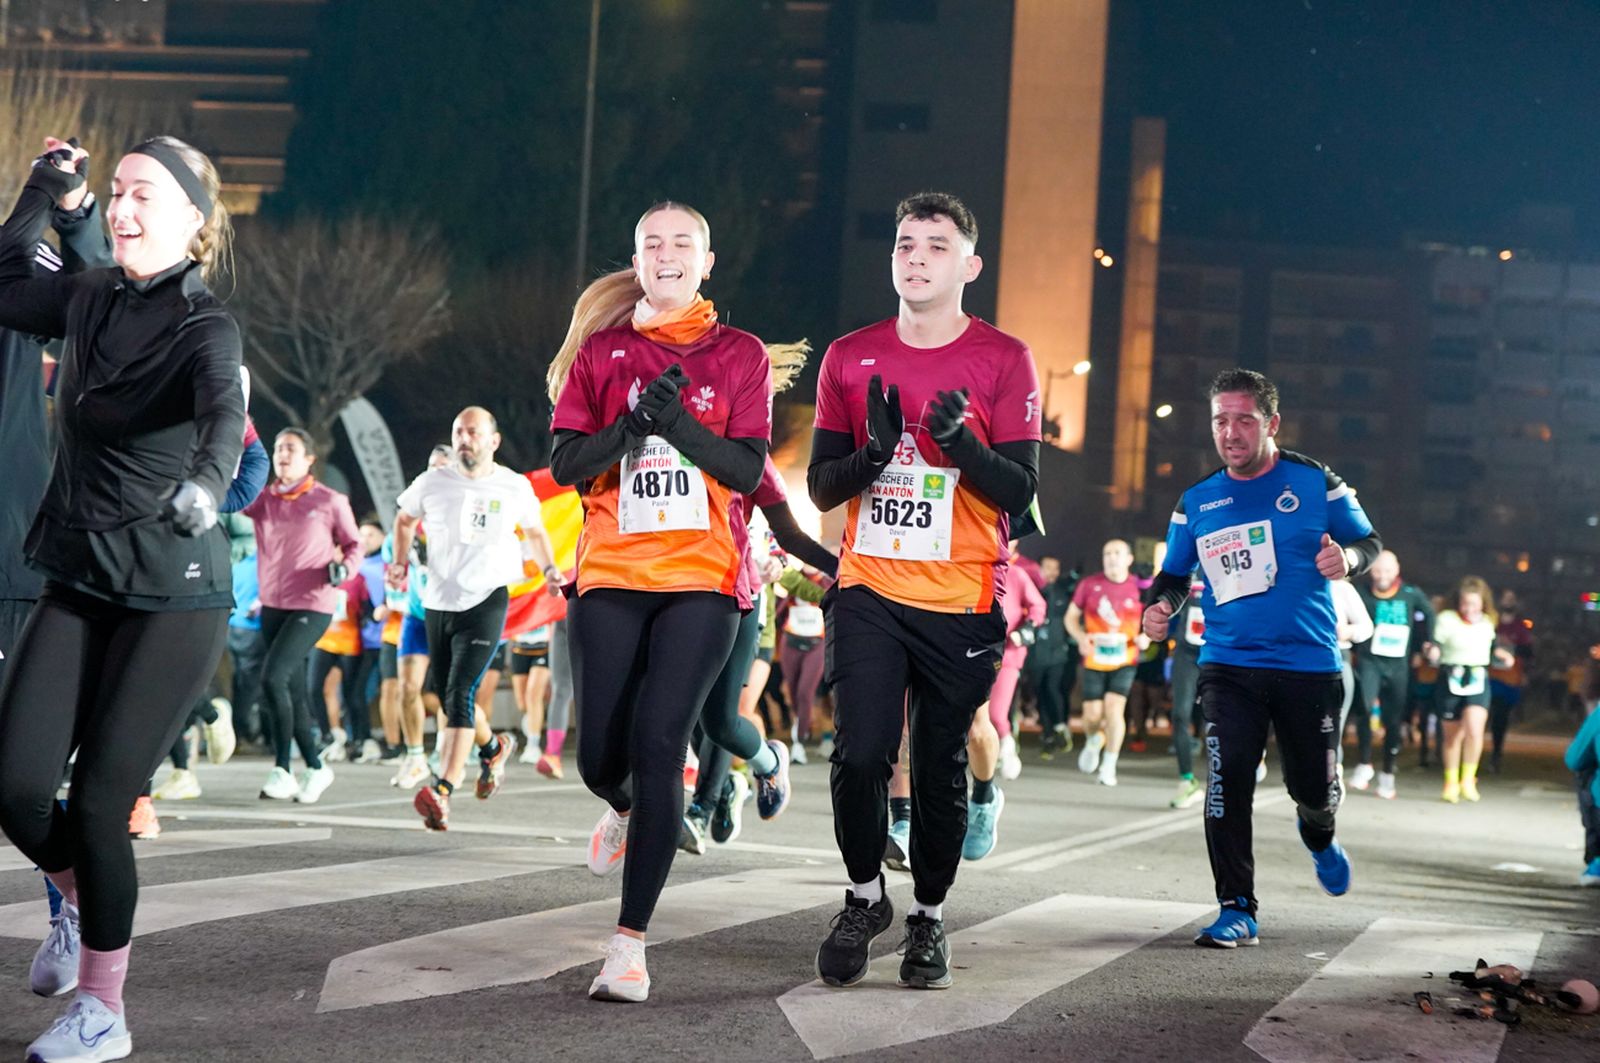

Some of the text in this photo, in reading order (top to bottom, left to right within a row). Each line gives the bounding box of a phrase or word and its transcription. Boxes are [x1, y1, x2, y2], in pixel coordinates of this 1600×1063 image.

[632, 469, 690, 499] 4870
[877, 474, 915, 486] OCHE DE
[882, 485, 915, 498] ANTÓN
[871, 497, 932, 528] 5623
[1199, 497, 1233, 512] macron
[1221, 549, 1252, 575] 943
